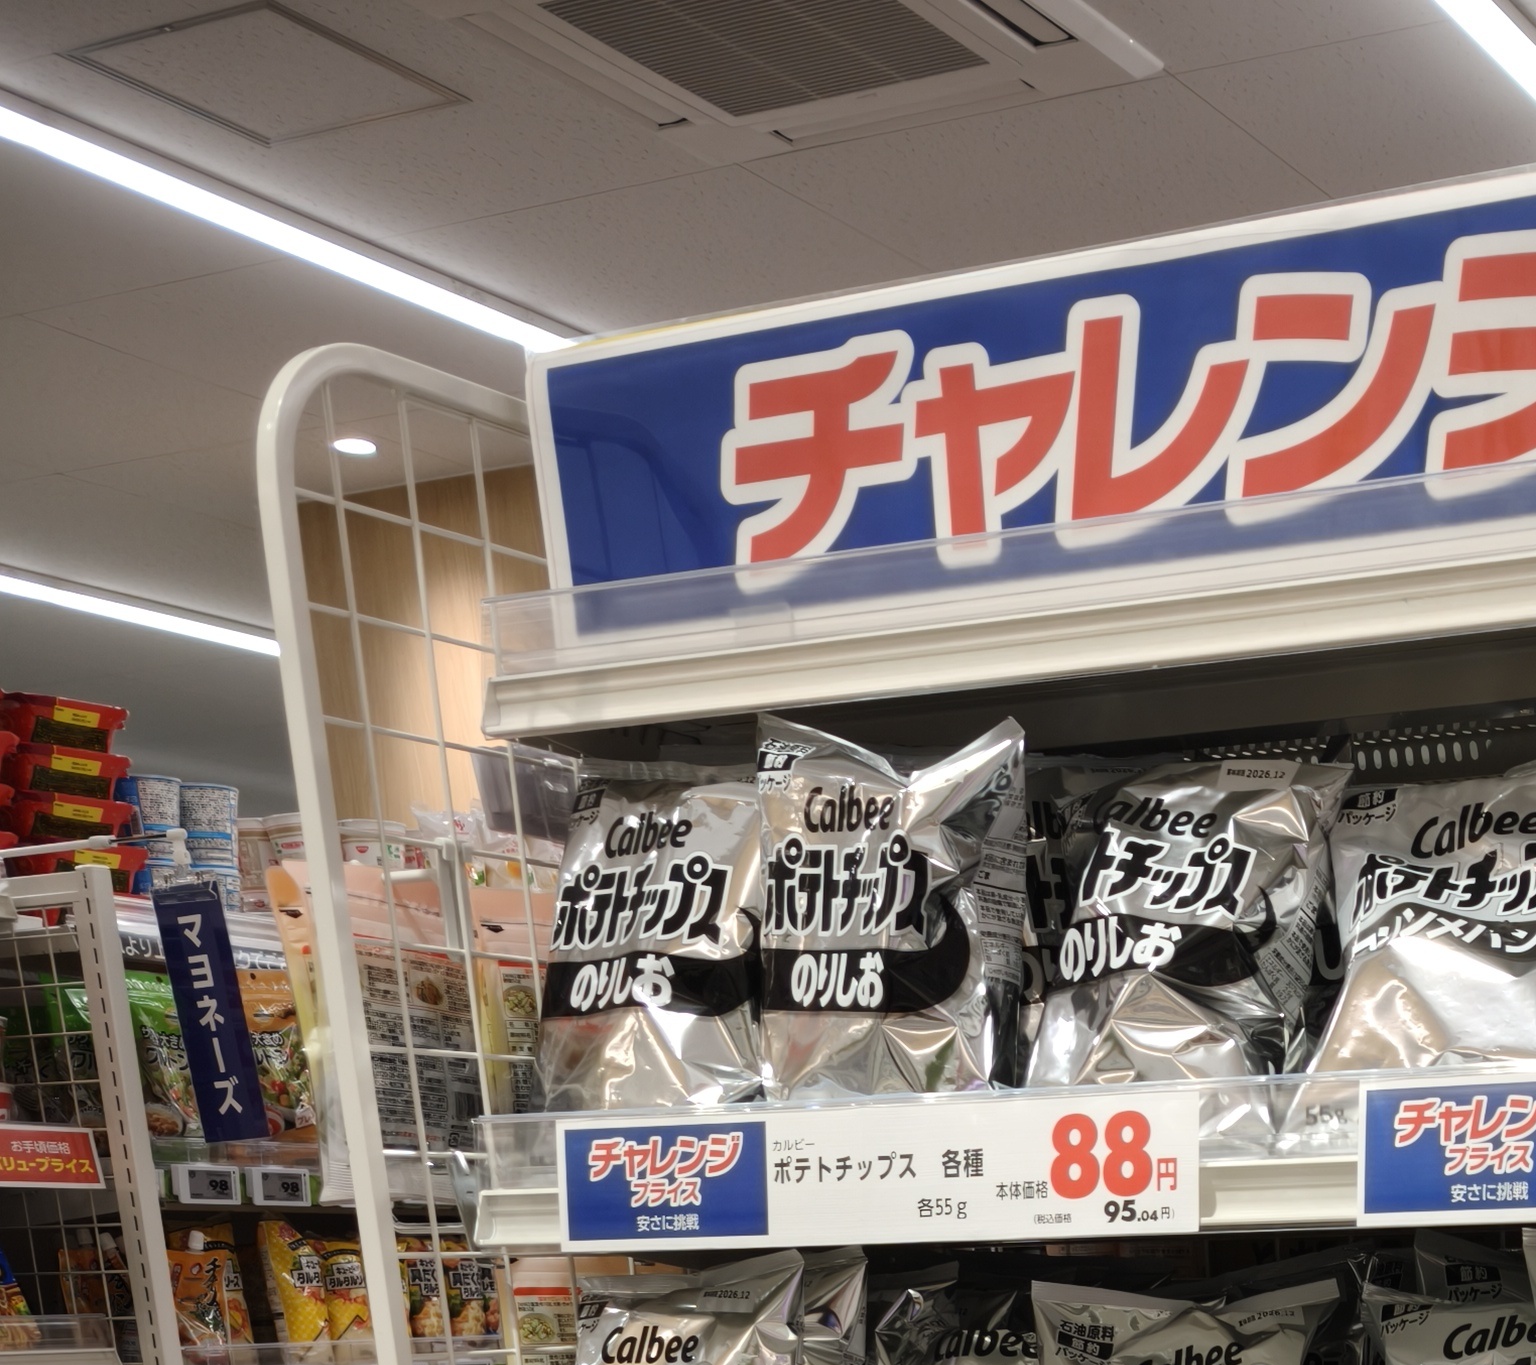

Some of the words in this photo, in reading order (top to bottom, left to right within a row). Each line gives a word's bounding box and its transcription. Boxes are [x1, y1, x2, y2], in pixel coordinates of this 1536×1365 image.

[804, 786, 895, 833] Calbee
[604, 816, 693, 860] Calbee
[552, 856, 733, 951] ポテトチップス
[1059, 917, 1182, 983] のりしお
[570, 953, 674, 1009] のりしお
[791, 953, 884, 1008] のりしお
[177, 915, 243, 1116] マヨネーズ
[10, 1141, 71, 1155] お手頃価格
[773, 1150, 917, 1185] ポテトチップス
[1443, 1140, 1535, 1176] プライス
[208, 1178, 230, 1193] 98
[1450, 1180, 1529, 1203] 安さに挑戦
[601, 1325, 699, 1365] Calbee
[1059, 1320, 1116, 1341] 石油原料
